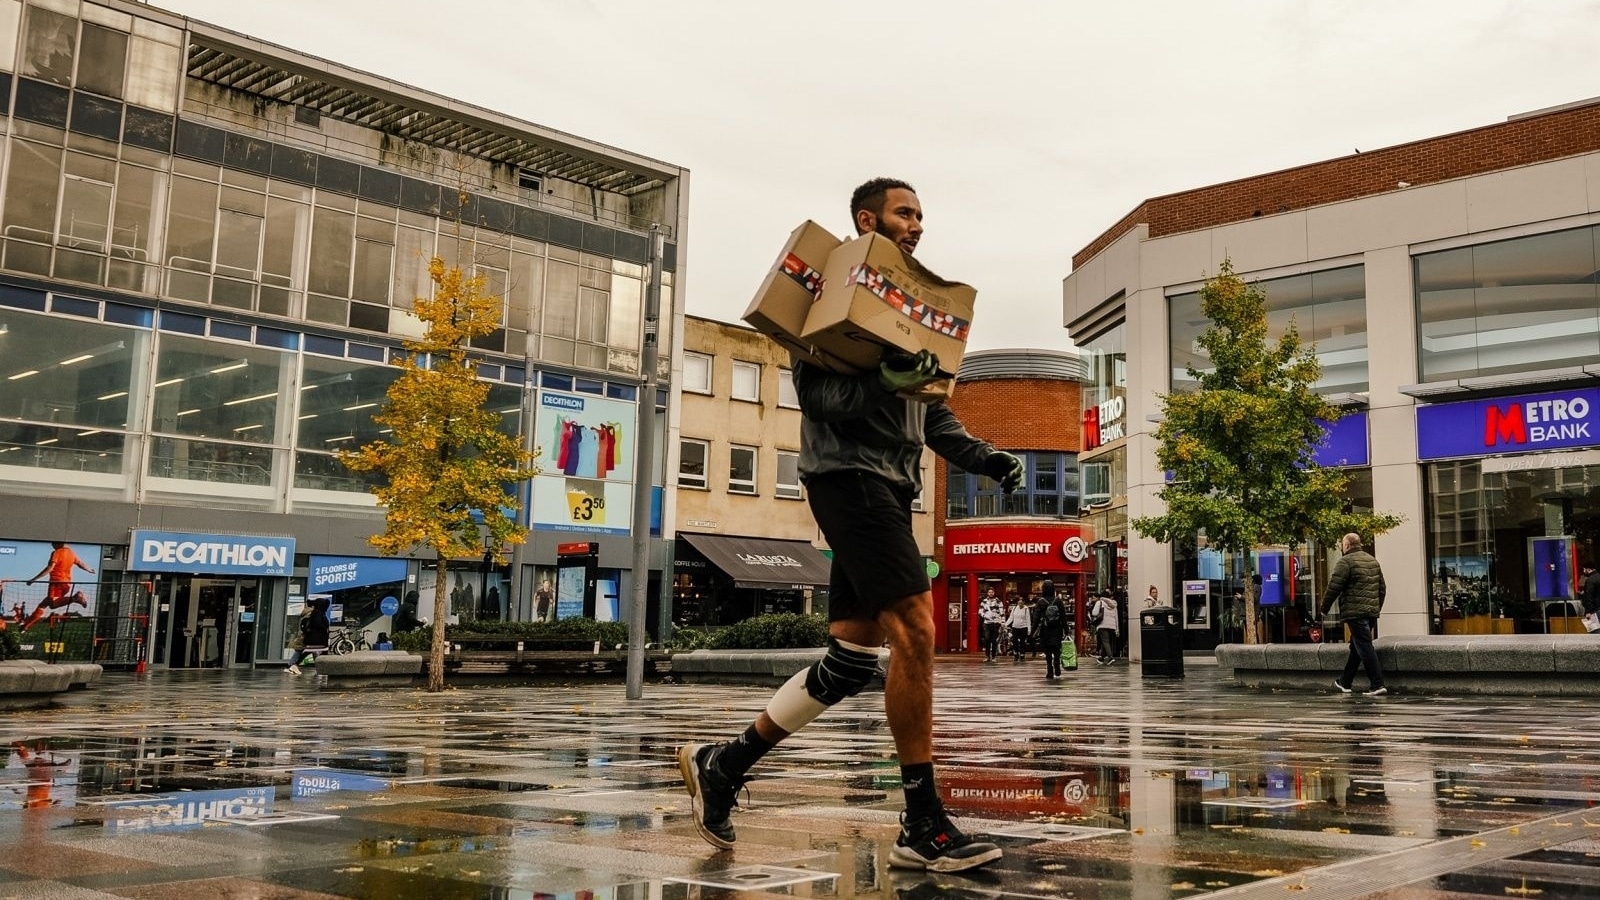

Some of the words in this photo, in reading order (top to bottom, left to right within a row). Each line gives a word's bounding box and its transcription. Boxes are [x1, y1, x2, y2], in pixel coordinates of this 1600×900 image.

[543, 395, 582, 407] DECATHLON
[1484, 397, 1590, 447] METRO
[1100, 422, 1124, 445] BANK
[1530, 423, 1591, 442] BANK
[1503, 457, 1534, 469] OPEN
[1539, 455, 1547, 467] 7
[1551, 457, 1582, 466] DAYS
[142, 540, 286, 567] DECATHLON
[953, 543, 1051, 555] ENTERTAINMENT
[321, 565, 347, 573] FLOORS
[348, 562, 358, 570] OF
[315, 571, 356, 586] SPORTS!
